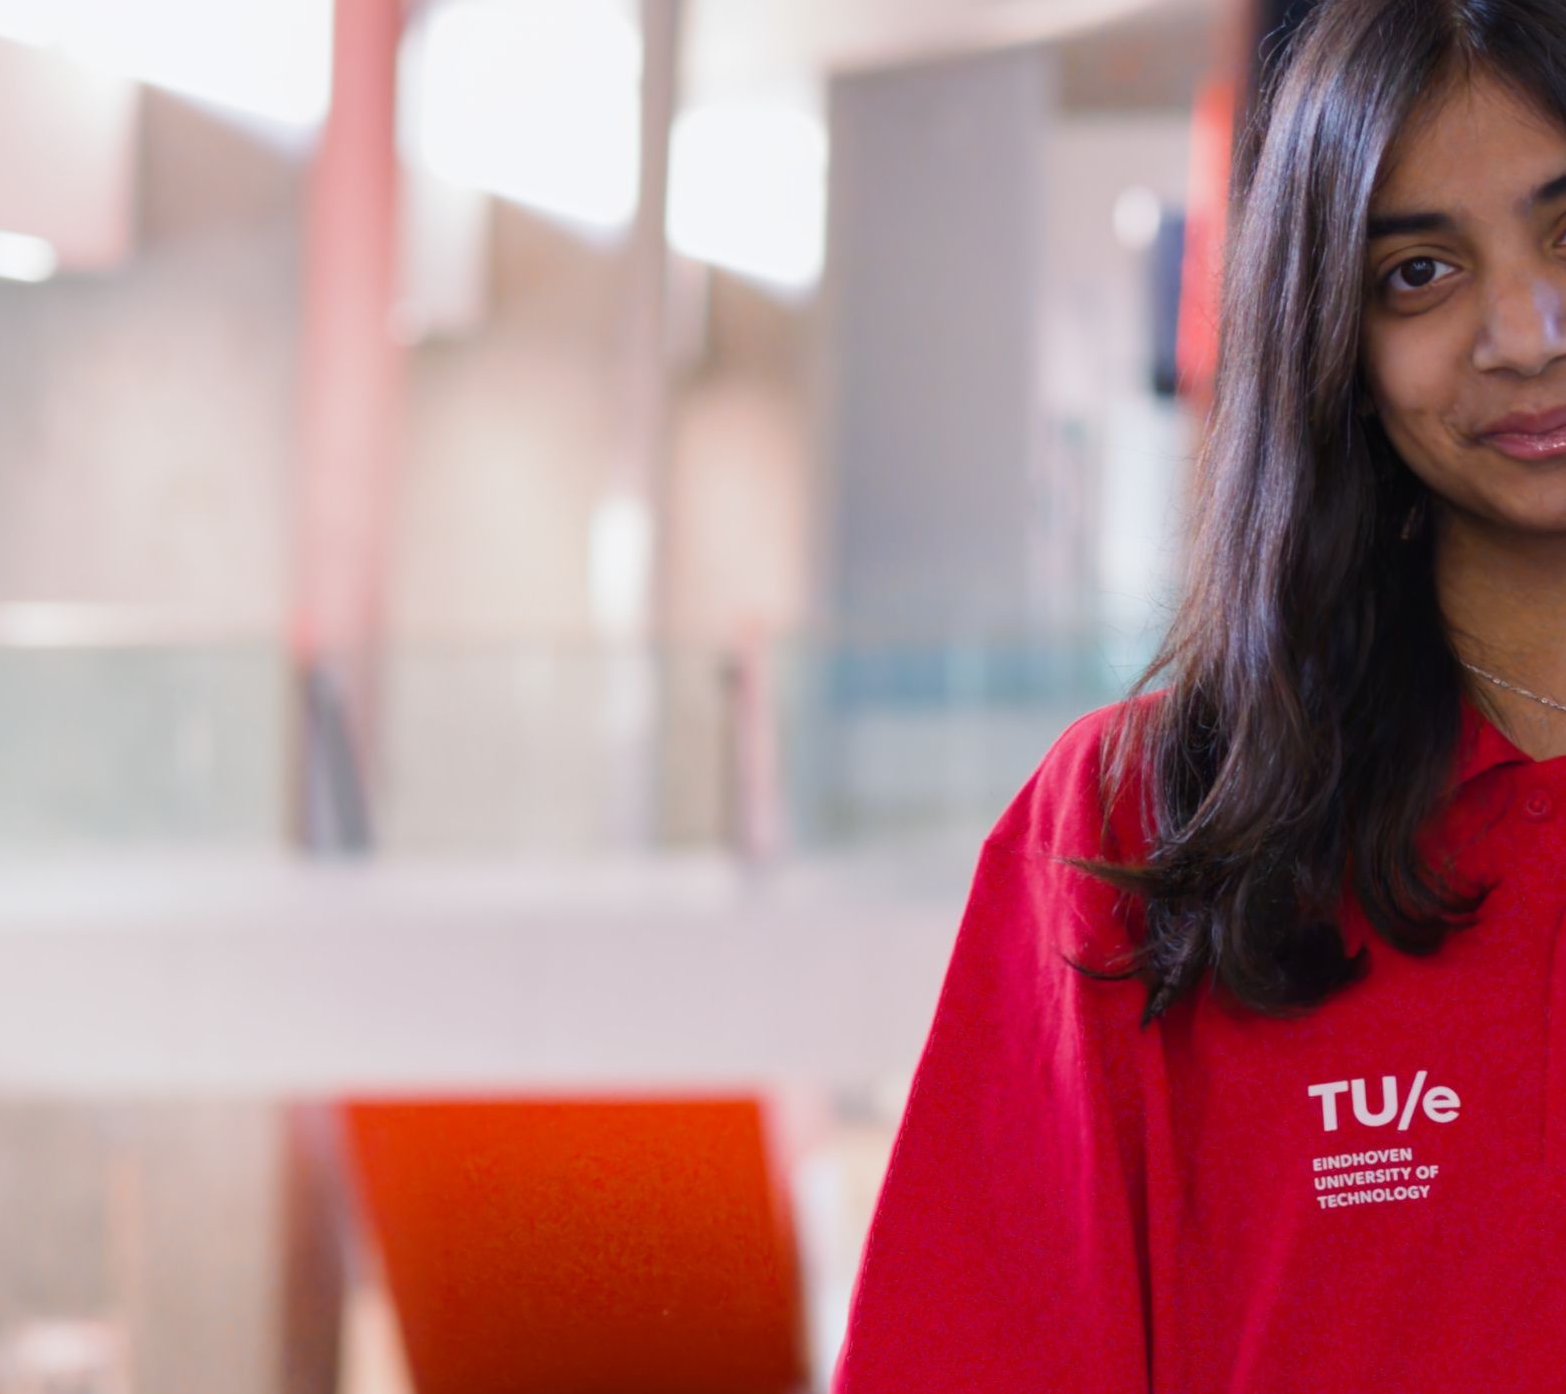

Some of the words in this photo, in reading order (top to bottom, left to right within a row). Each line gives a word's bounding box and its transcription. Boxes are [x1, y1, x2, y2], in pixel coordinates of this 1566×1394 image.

[1307, 1070, 1461, 1132] TU/e
[1312, 1147, 1413, 1172] EINDHOVEN
[1314, 1166, 1412, 1191] UNIVERSITY
[1415, 1165, 1439, 1180] OF
[1316, 1185, 1431, 1210] TECHNOLOGY
